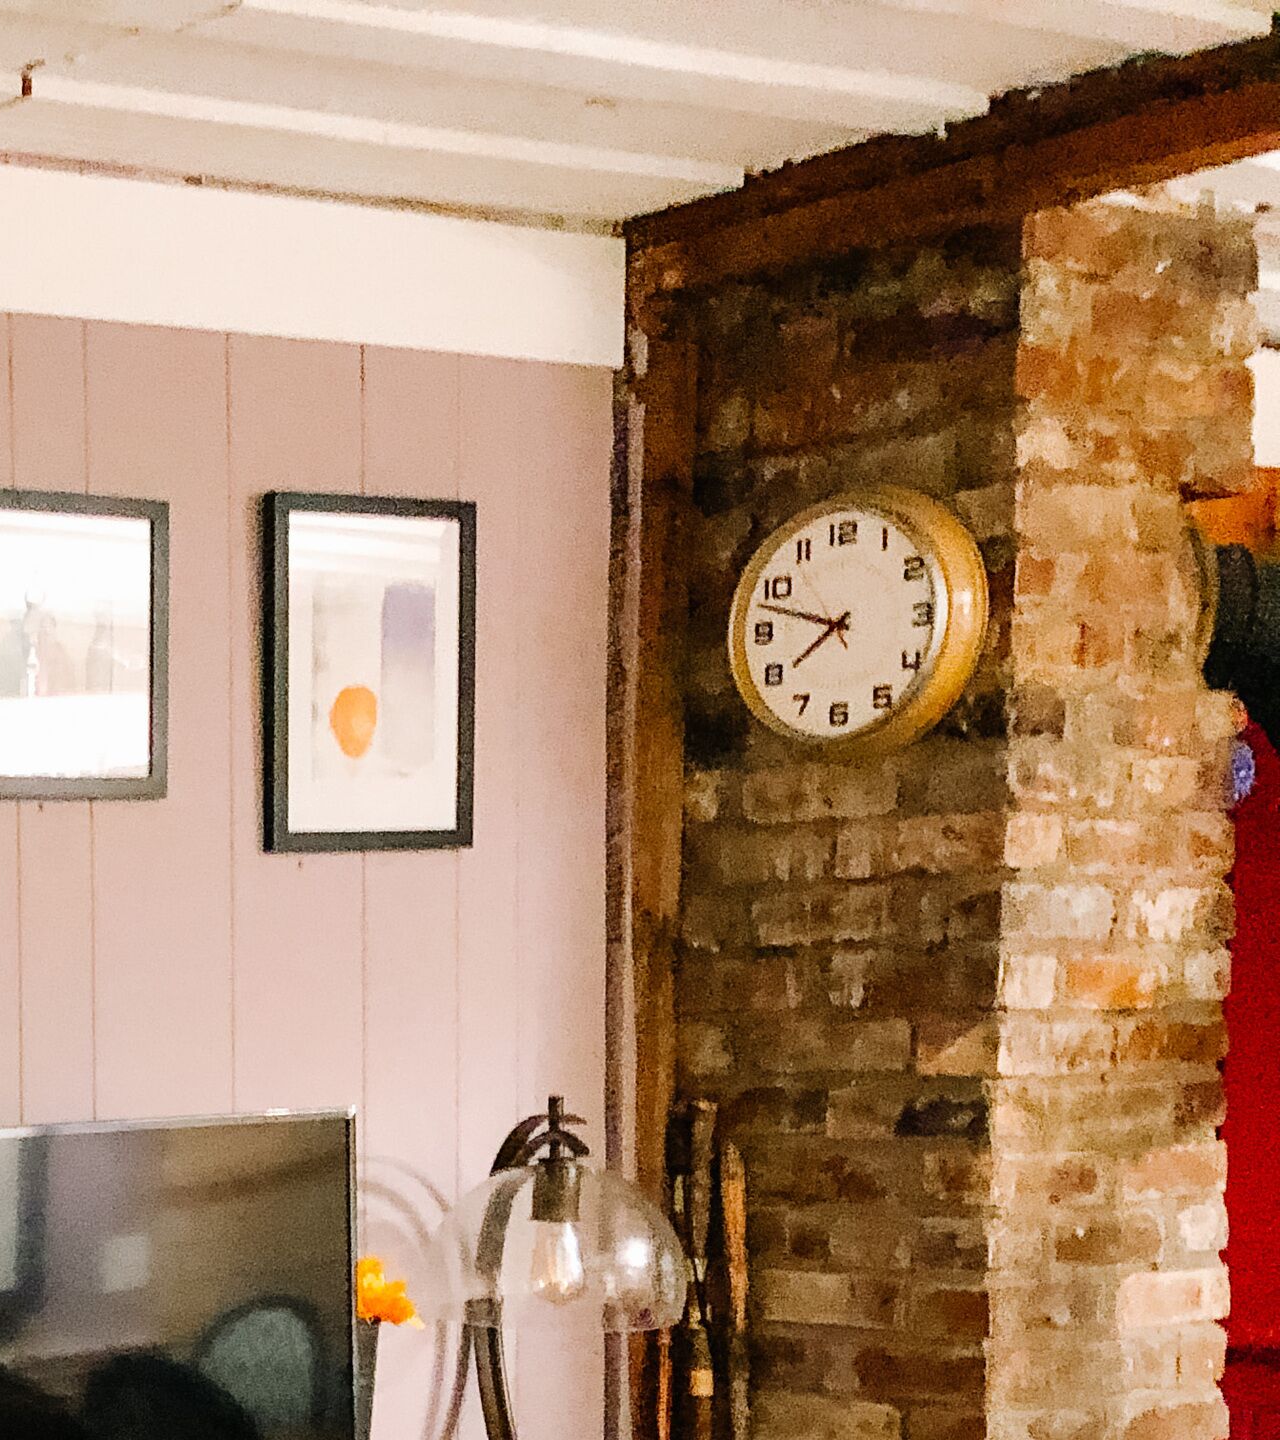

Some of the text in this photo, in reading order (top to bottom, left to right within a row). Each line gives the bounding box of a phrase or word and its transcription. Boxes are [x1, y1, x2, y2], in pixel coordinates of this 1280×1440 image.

[829, 519, 858, 546] 12
[763, 575, 793, 601] 10
[754, 621, 774, 646] 9
[901, 650, 921, 671] 4
[764, 662, 784, 687] 8
[792, 692, 811, 718] 7
[828, 701, 850, 728] 6
